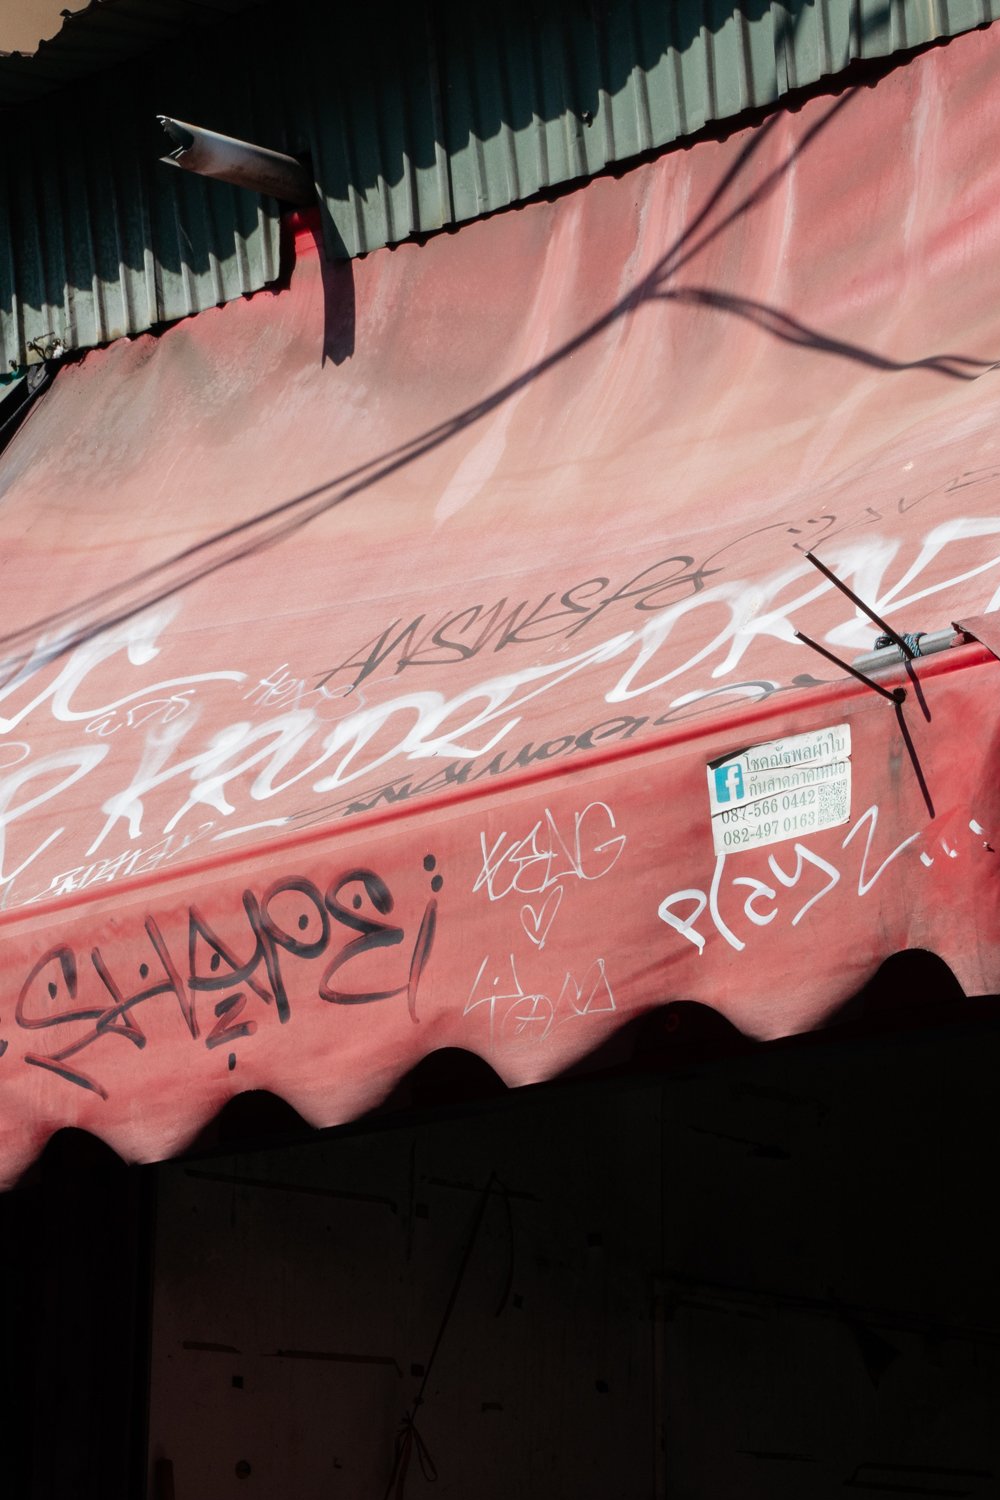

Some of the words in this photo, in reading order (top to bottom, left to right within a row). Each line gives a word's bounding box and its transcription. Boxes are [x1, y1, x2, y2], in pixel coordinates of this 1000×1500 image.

[782, 790, 816, 810] 0442
[723, 821, 779, 846] 082-497
[783, 811, 816, 831] 0163
